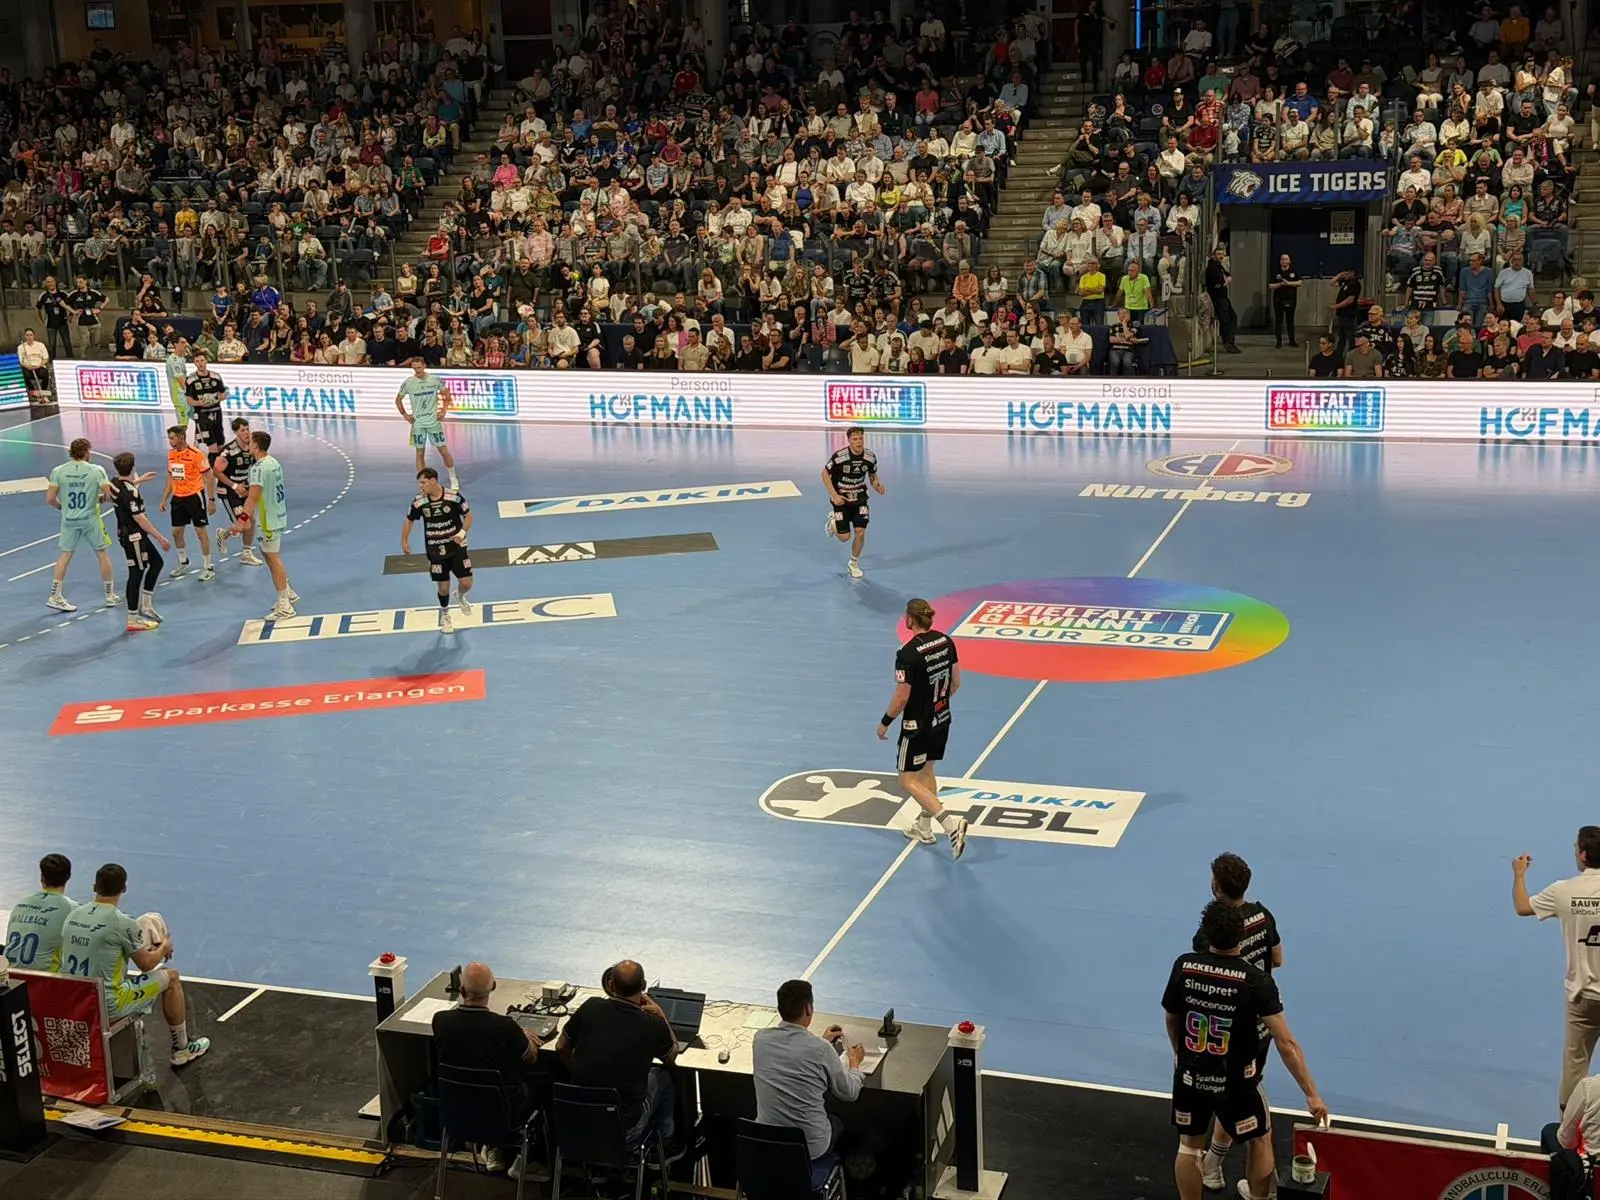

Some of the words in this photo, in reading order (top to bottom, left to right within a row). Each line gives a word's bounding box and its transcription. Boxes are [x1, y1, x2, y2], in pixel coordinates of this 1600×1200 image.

[1268, 174, 1301, 193] ICE
[1310, 171, 1387, 192] TIGERS
[81, 371, 140, 386] #VIELFALT
[298, 370, 354, 384] Personal
[671, 377, 732, 391] Personal
[82, 385, 141, 400] GEWINNT
[445, 380, 496, 394] VIELFALT
[831, 386, 902, 402] #VIELFALT
[1102, 383, 1172, 398] Personal
[225, 386, 356, 413] HOFMANN
[589, 394, 733, 422] HOFMANN
[1273, 392, 1357, 409] #VIELFALT
[832, 402, 901, 418] GEWINNT
[1007, 401, 1172, 431] HOFMANN
[1274, 408, 1355, 426] GEWINNT
[68, 491, 87, 510] 30
[575, 486, 771, 508] DAIKIN
[1078, 483, 1313, 508] Nürnberg
[438, 545, 447, 556] 3
[985, 603, 1162, 622] #VIELFALT
[978, 613, 1154, 632] GEWINNT
[973, 625, 1083, 642] TOUR
[1103, 632, 1193, 647] 2026
[929, 668, 950, 703] 77
[141, 696, 312, 721] Sparkasse
[323, 682, 466, 706] Erlangen
[970, 791, 1116, 810] DAIKIN
[945, 805, 1099, 835] HBL
[1571, 900, 1600, 908] BAUW
[5, 931, 40, 965] 20
[71, 935, 91, 947] SMITS
[1182, 961, 1247, 979] FACKELMANN
[1185, 995, 1237, 1012] devicenow
[1185, 1011, 1233, 1055] 95
[11, 1009, 33, 1078] SELECT
